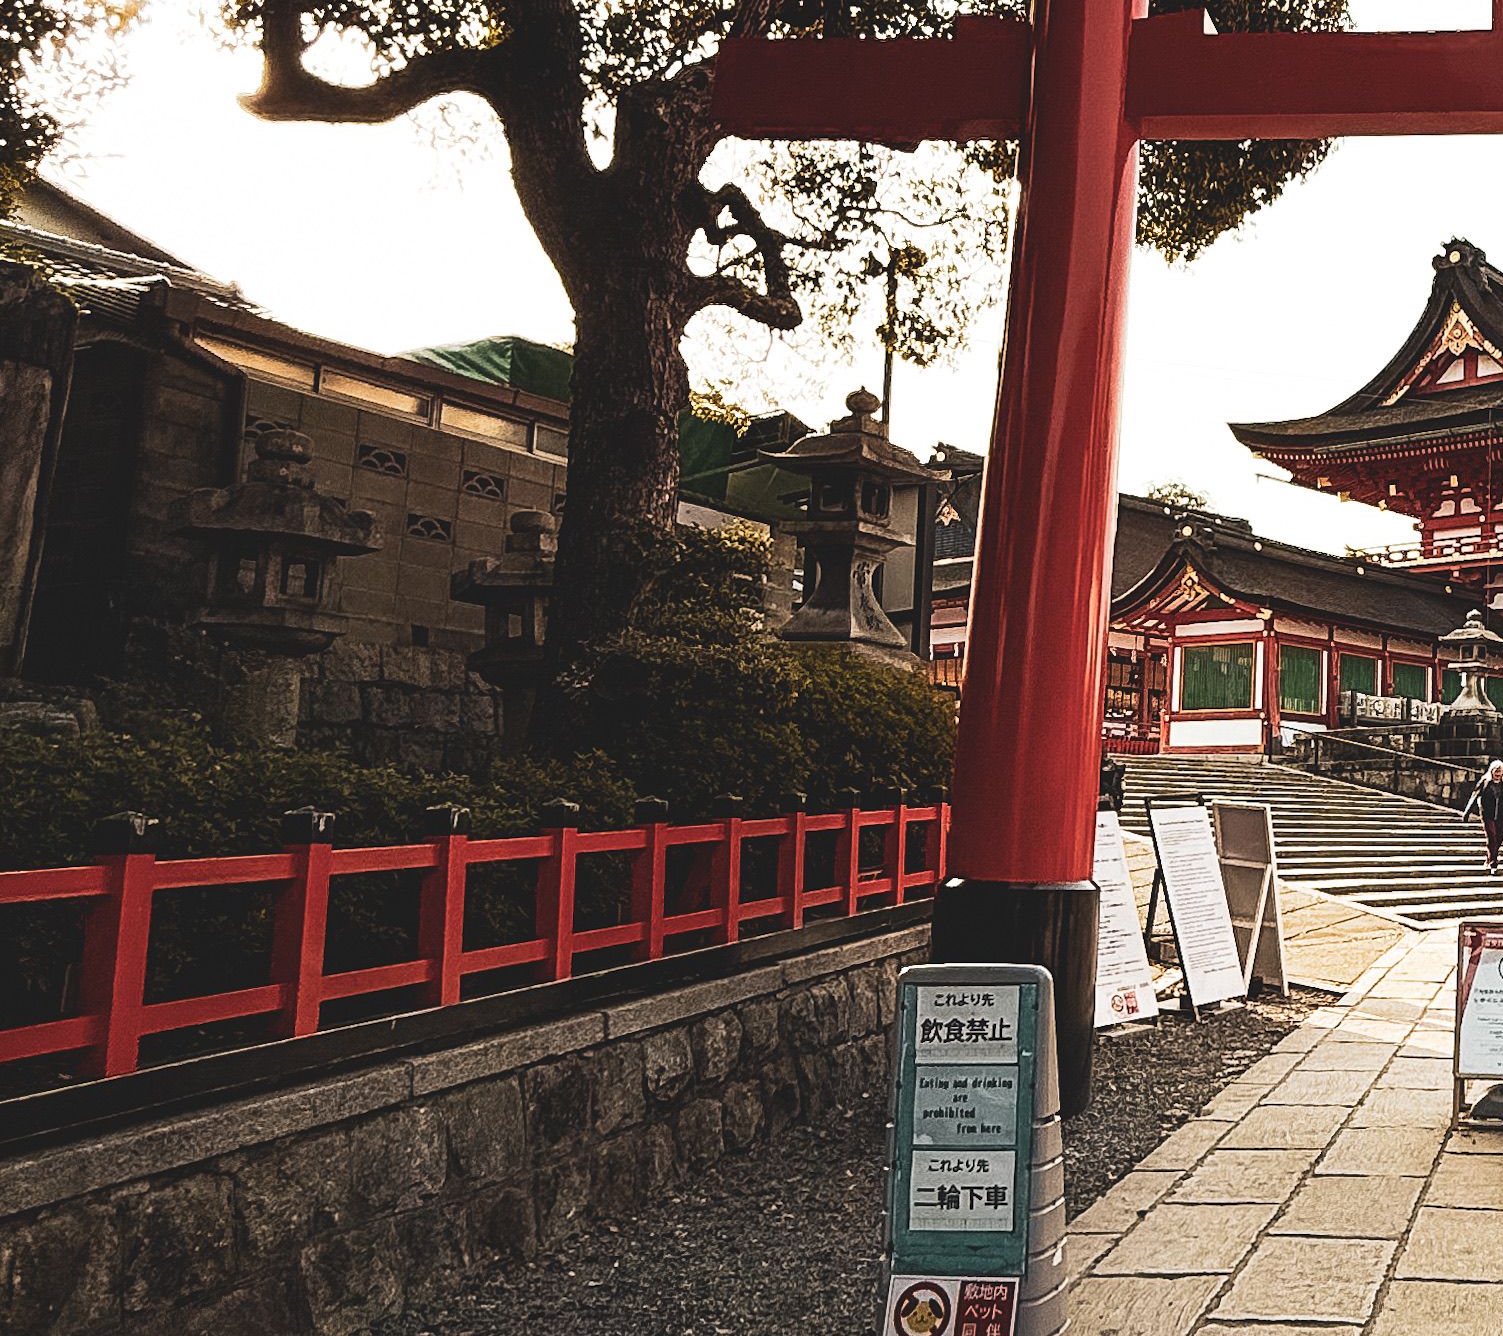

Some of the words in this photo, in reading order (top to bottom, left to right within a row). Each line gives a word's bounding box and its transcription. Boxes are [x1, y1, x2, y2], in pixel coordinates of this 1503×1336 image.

[934, 993, 995, 1007] これより先
[920, 1017, 1013, 1043] 飲食禁止
[919, 1076, 949, 1090] Eating
[953, 1077, 968, 1089] and
[972, 1076, 1013, 1089] drinking
[953, 1094, 968, 1103] are
[923, 1107, 976, 1119] prohibited
[957, 1122, 977, 1134] from
[981, 1122, 1001, 1134] here
[928, 1158, 990, 1173] これより先
[914, 1184, 1008, 1210] 二輪下車
[963, 1283, 1008, 1300] 敷地内
[965, 1303, 1002, 1320] ペット
